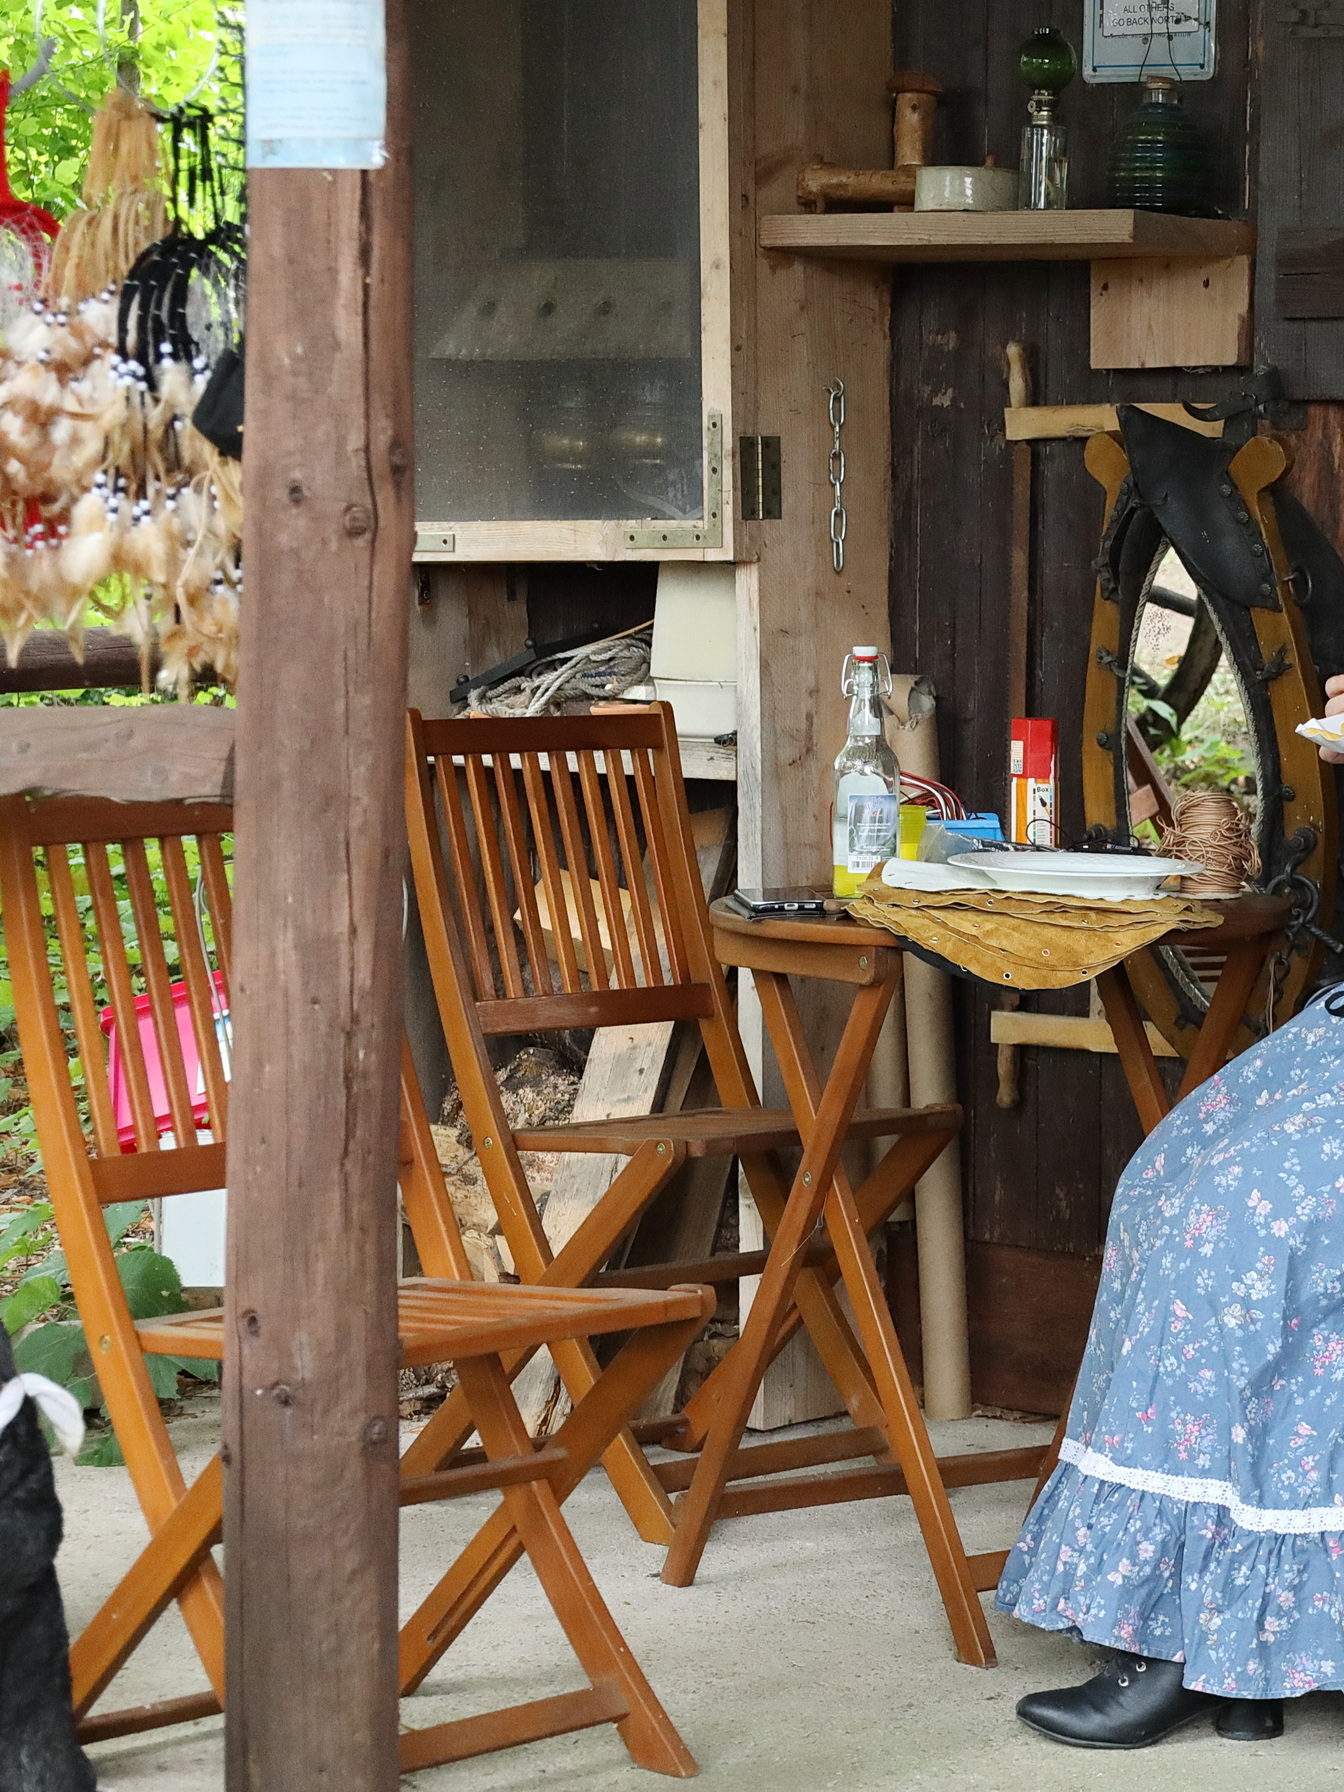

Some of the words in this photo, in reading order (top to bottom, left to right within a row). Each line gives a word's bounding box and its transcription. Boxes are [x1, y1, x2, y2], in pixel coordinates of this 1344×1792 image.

[1123, 5, 1138, 13] ALL
[1139, 3, 1175, 12] OTHERS
[1112, 18, 1125, 27] GO
[1126, 17, 1149, 26] BACK
